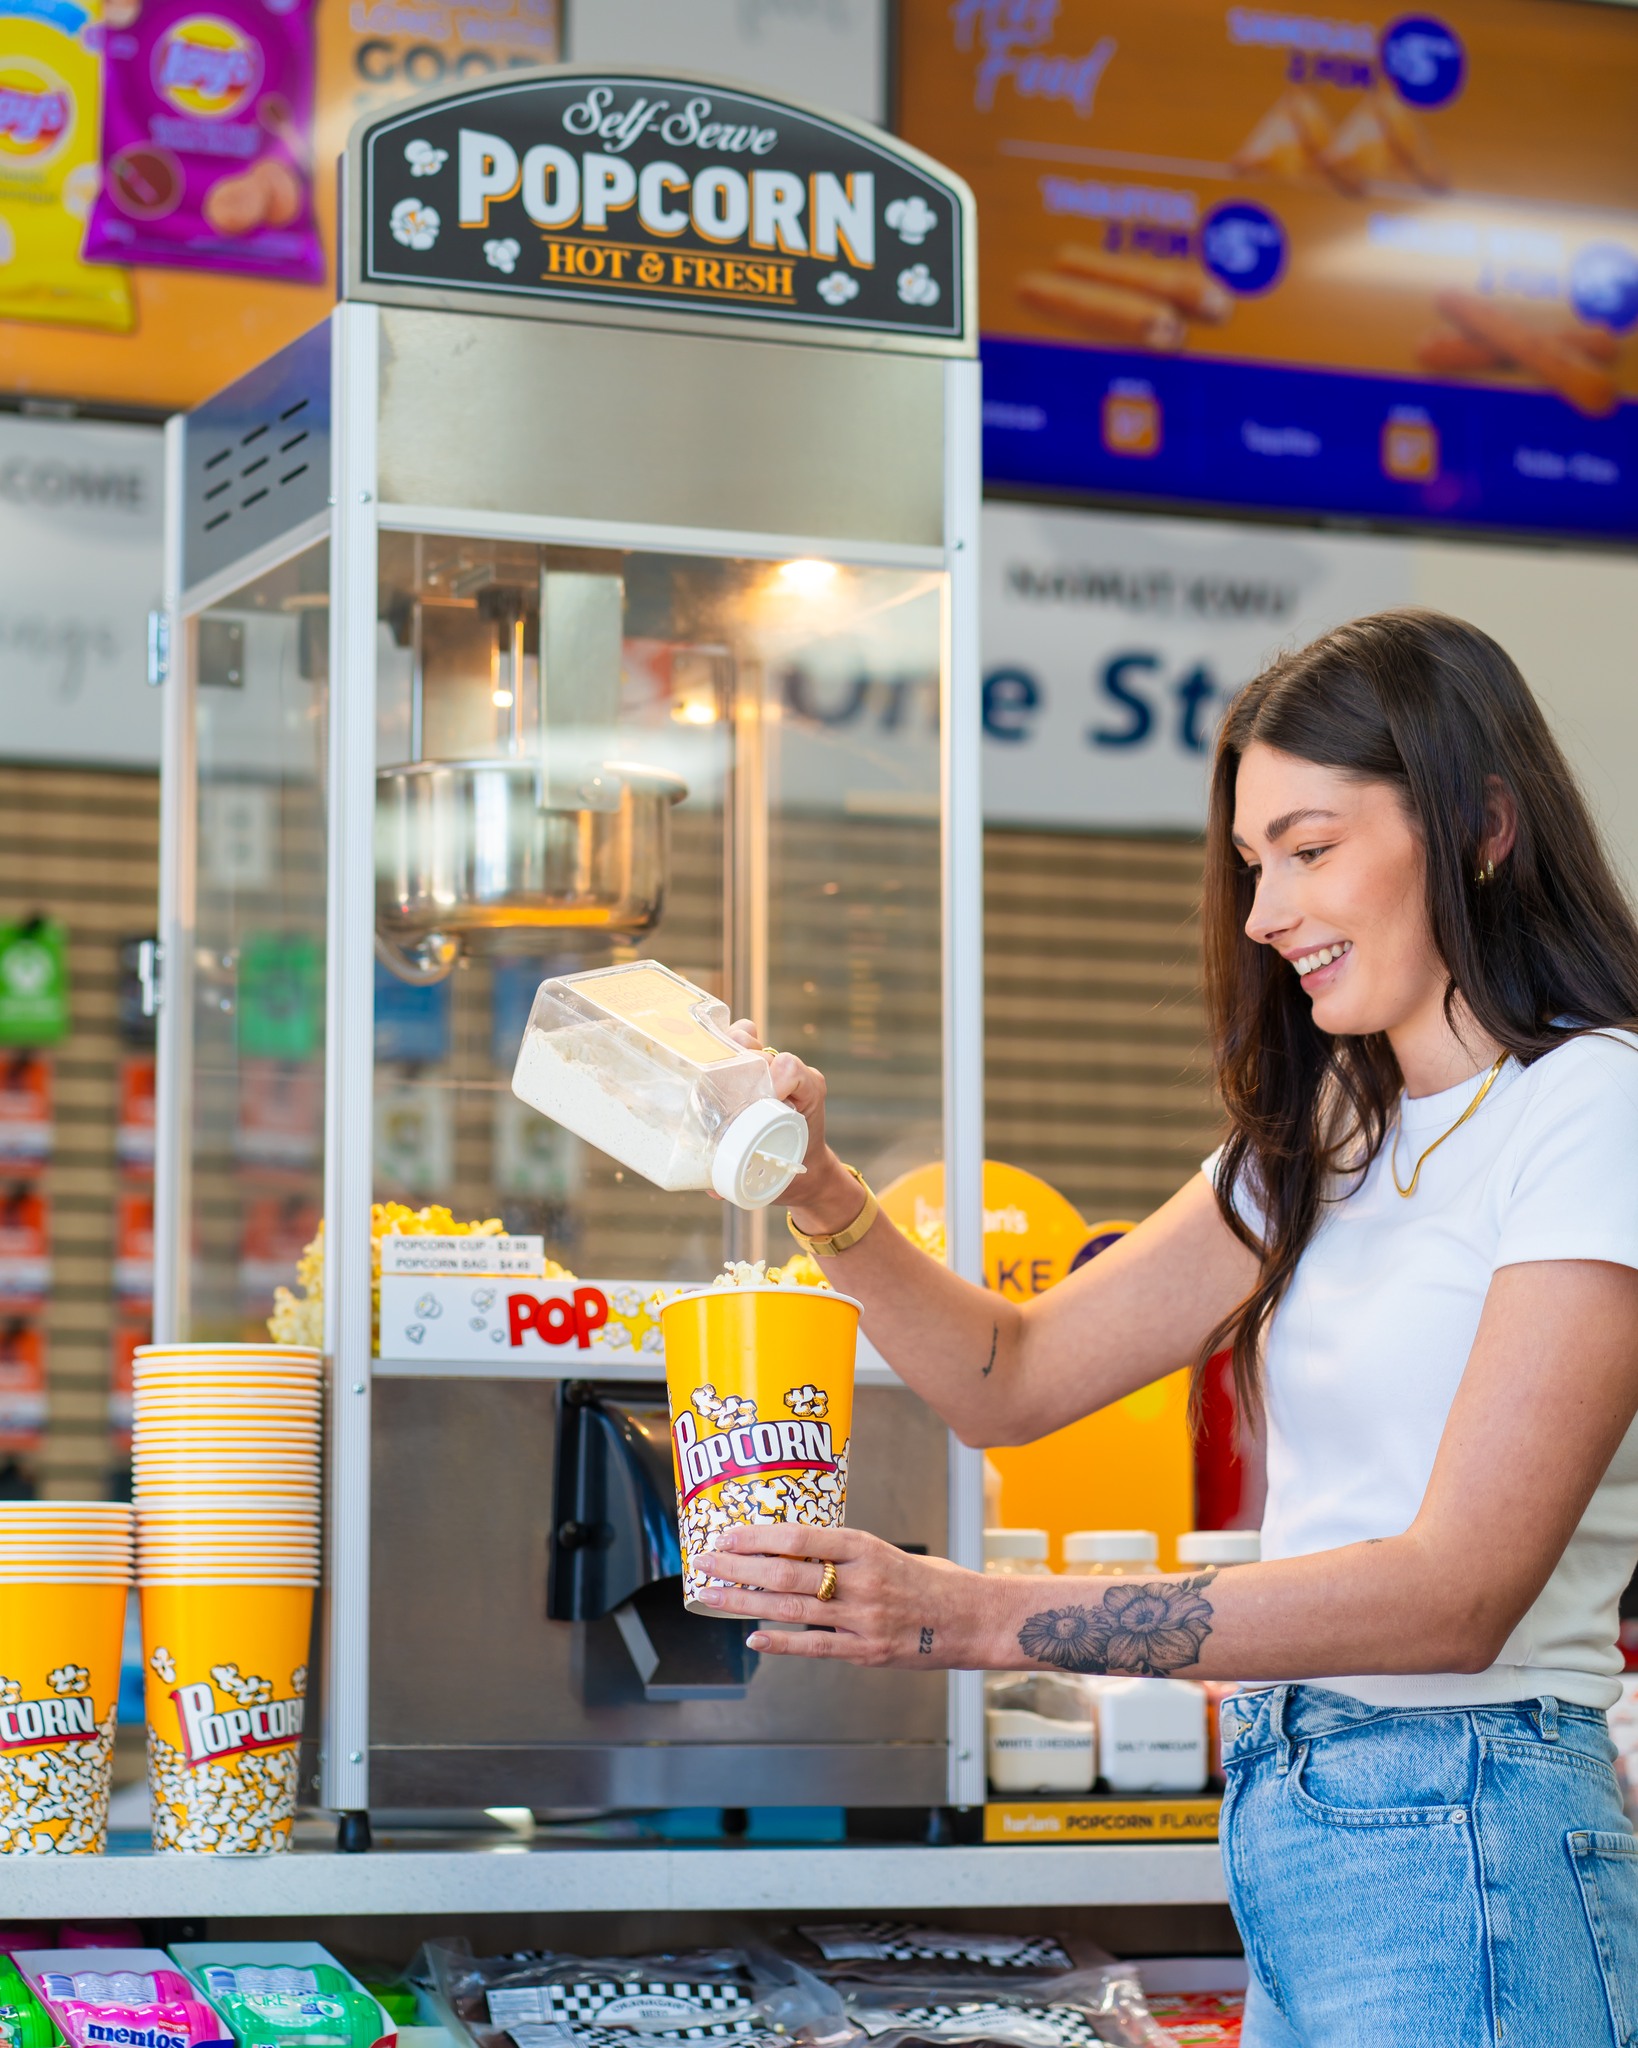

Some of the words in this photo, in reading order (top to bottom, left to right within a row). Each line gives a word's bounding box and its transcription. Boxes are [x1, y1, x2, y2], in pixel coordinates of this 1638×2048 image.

[355, 40, 546, 87] GOO
[562, 87, 778, 155] Self-Serve
[457, 128, 876, 269] POPCORN
[548, 243, 631, 278] HOT
[637, 252, 665, 283] &
[672, 256, 794, 296] FRESH
[394, 1239, 456, 1250] POPCORN
[396, 1257, 458, 1269] POPCORN
[462, 1259, 488, 1270] BAG
[508, 1287, 608, 1349] POP
[673, 1410, 833, 1498] POPCORN
[919, 1626, 934, 1654] 222
[177, 1682, 304, 1763] POPCOR
[995, 1738, 1033, 1749] WHITE
[1066, 1814, 1154, 1831] POPCORN
[87, 2022, 186, 2048] mentos
